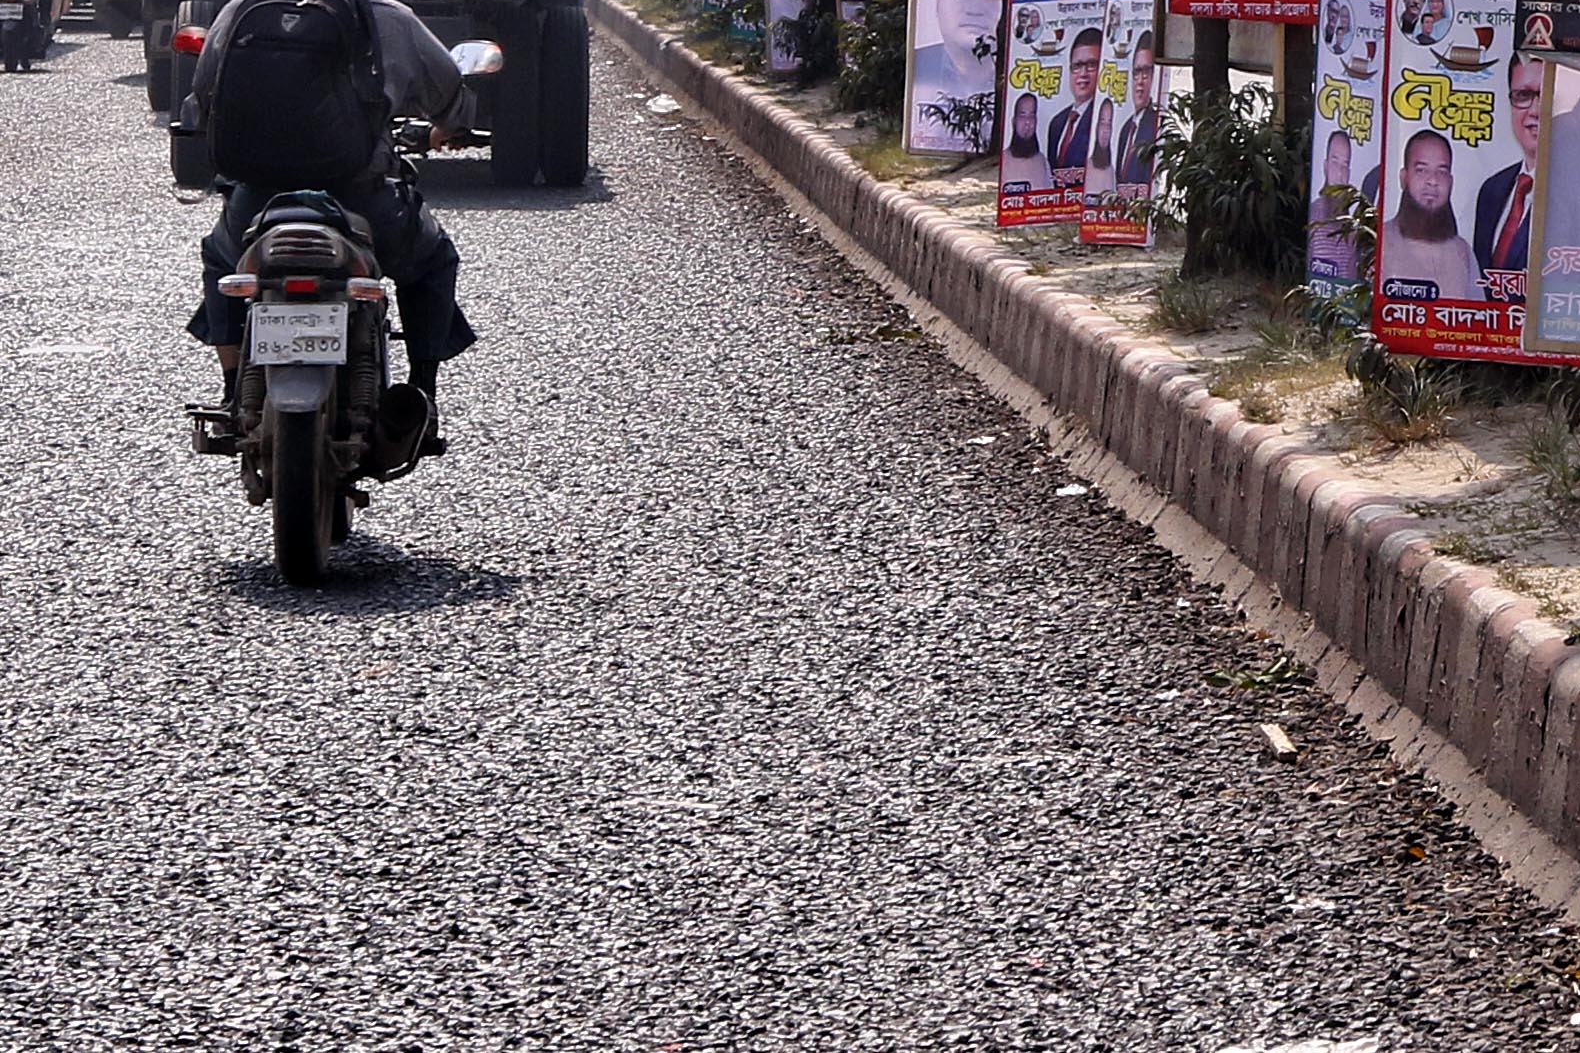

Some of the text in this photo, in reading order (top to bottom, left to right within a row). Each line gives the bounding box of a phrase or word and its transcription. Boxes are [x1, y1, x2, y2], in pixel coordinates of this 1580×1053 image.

[1521, 2, 1562, 14] সাভার
[1457, 11, 1484, 25] শেখ
[1382, 302, 1498, 329] মোঃ বাদশা
